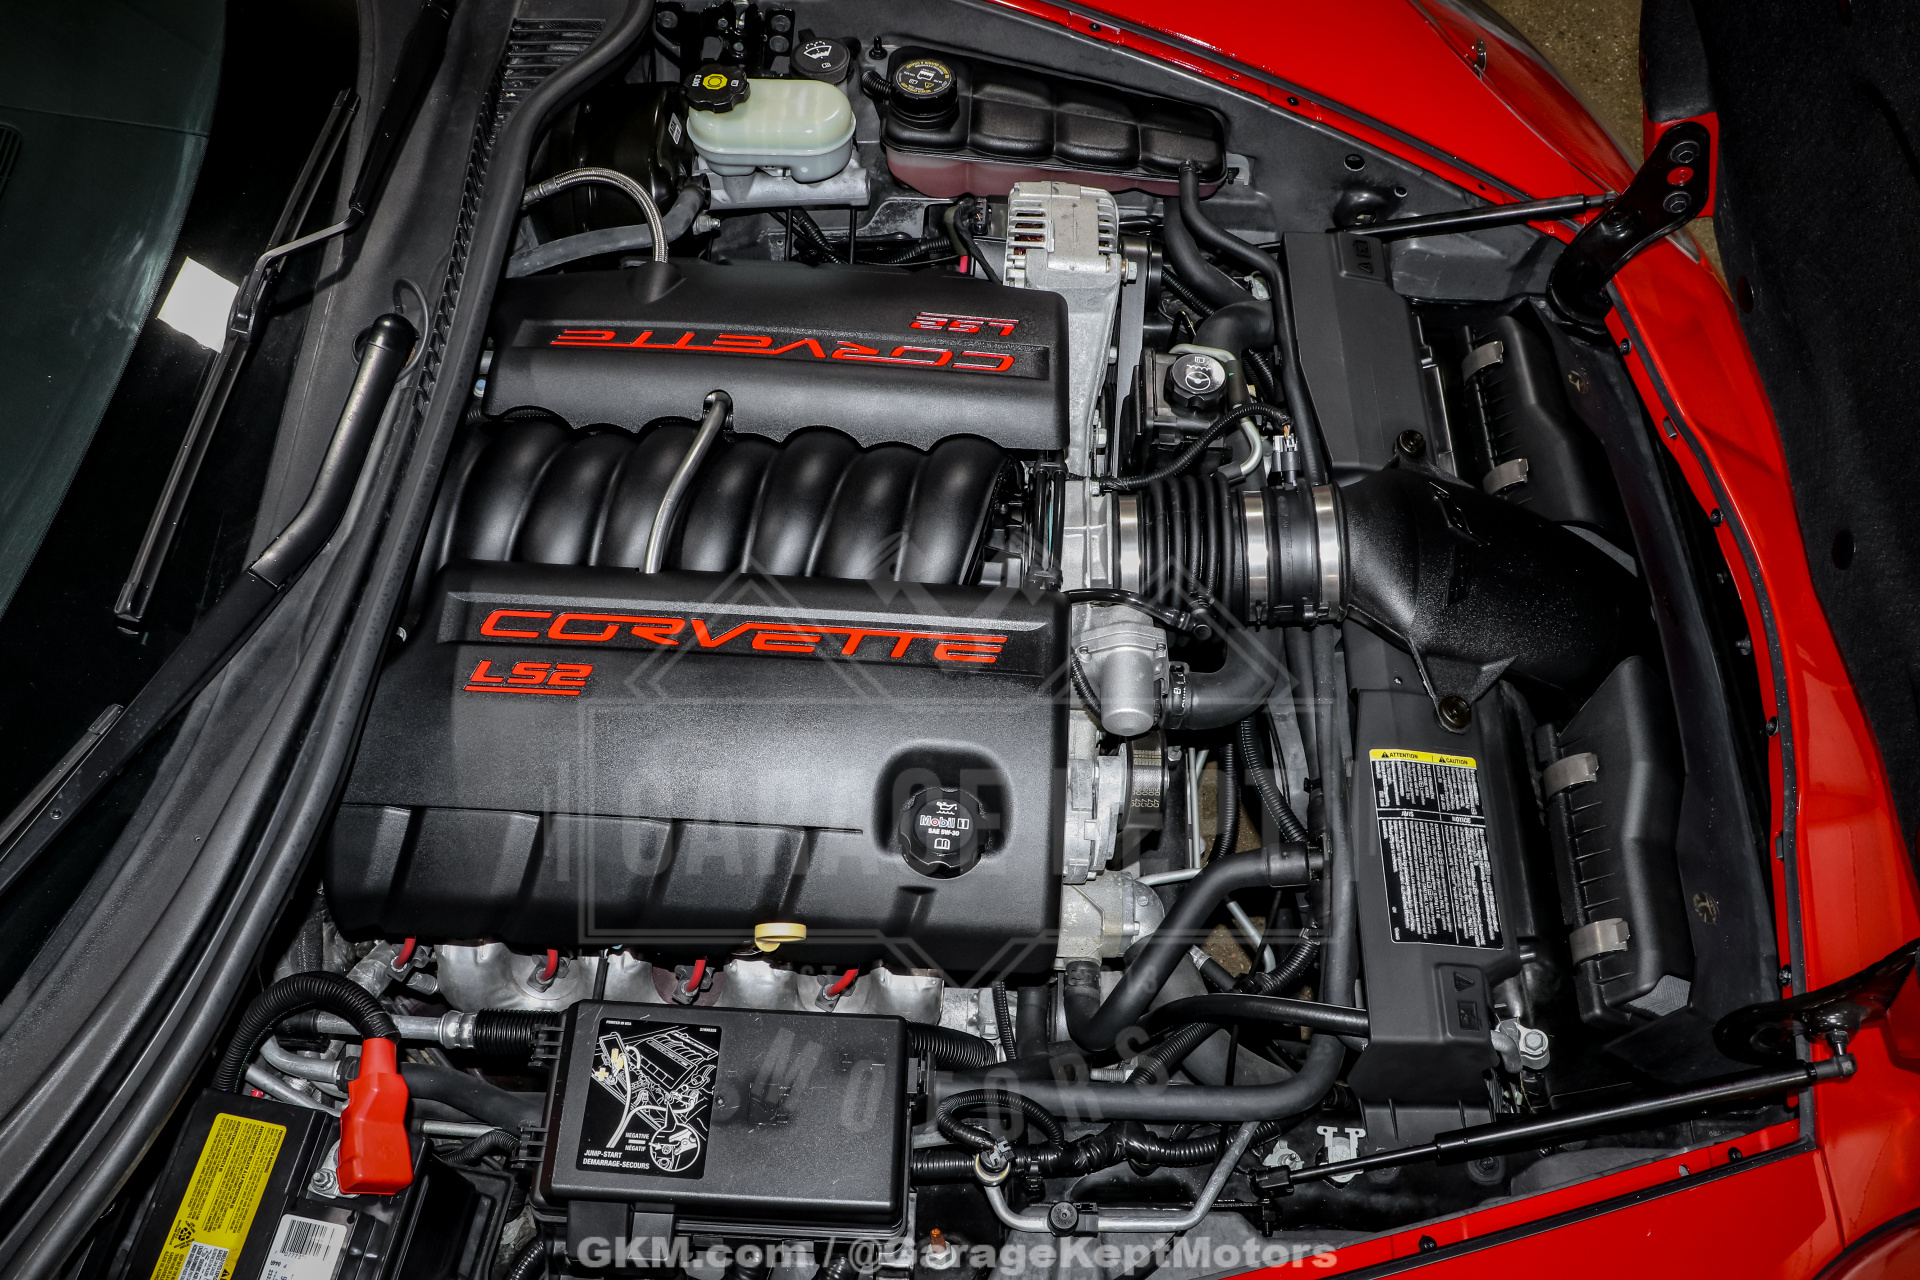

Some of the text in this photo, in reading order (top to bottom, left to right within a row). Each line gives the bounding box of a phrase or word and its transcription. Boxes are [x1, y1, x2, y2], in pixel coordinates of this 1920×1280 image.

[910, 311, 1020, 337] LS2
[550, 330, 1016, 373] CORVETTE
[479, 609, 1009, 663] CORVETTE
[463, 659, 594, 696] LS2
[1389, 752, 1419, 760] ATTENTION
[919, 814, 970, 830] Mobil 1
[1451, 816, 1472, 824] NOTICE
[927, 827, 960, 837] SAE 5W-30
[625, 1132, 650, 1140] NEGATIVE
[624, 1144, 647, 1152] NÉGATIF
[583, 1149, 623, 1159] JUMP-START
[582, 1158, 650, 1170] DEMARRAGE-SECOURS
